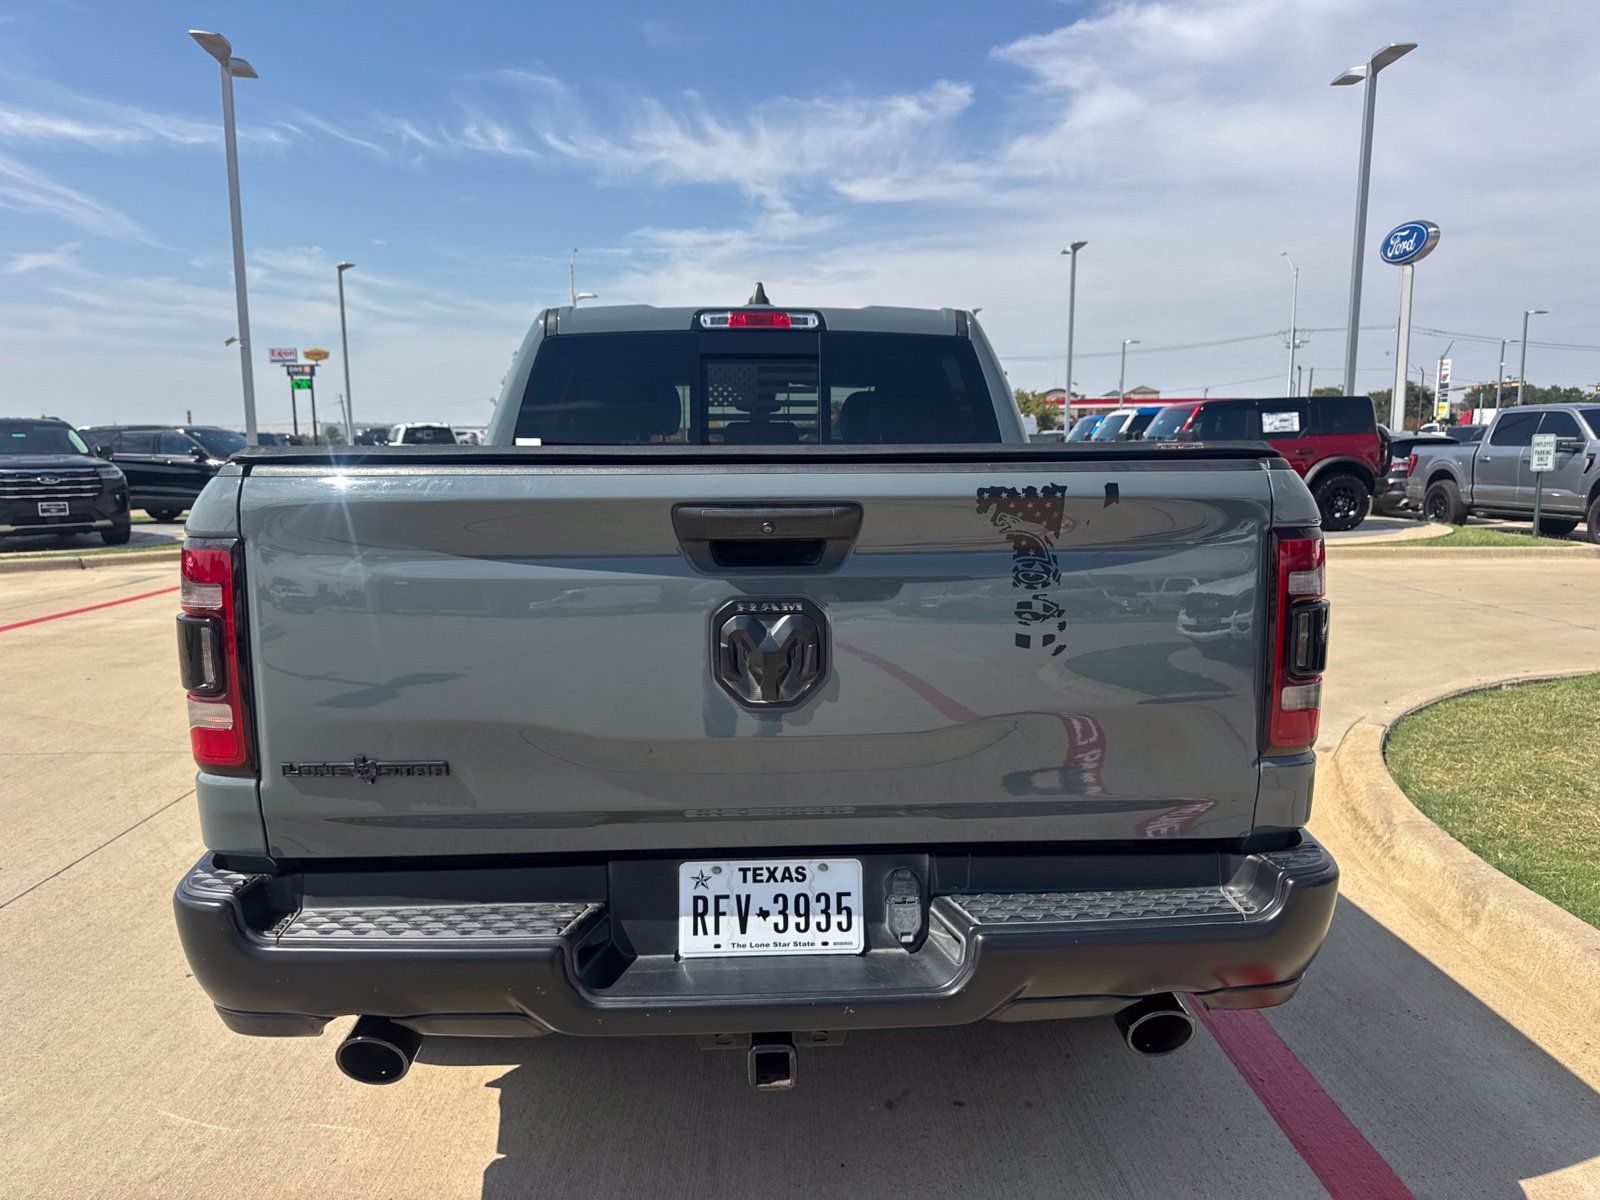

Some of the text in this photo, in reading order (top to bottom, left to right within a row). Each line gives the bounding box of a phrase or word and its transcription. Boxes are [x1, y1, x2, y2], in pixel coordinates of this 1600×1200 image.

[1386, 229, 1417, 258] Ford
[736, 601, 803, 612] RAM
[738, 866, 807, 884] TEXAS
[692, 891, 852, 936] RFV 3935
[749, 941, 771, 949] Lone
[793, 940, 815, 948] State
